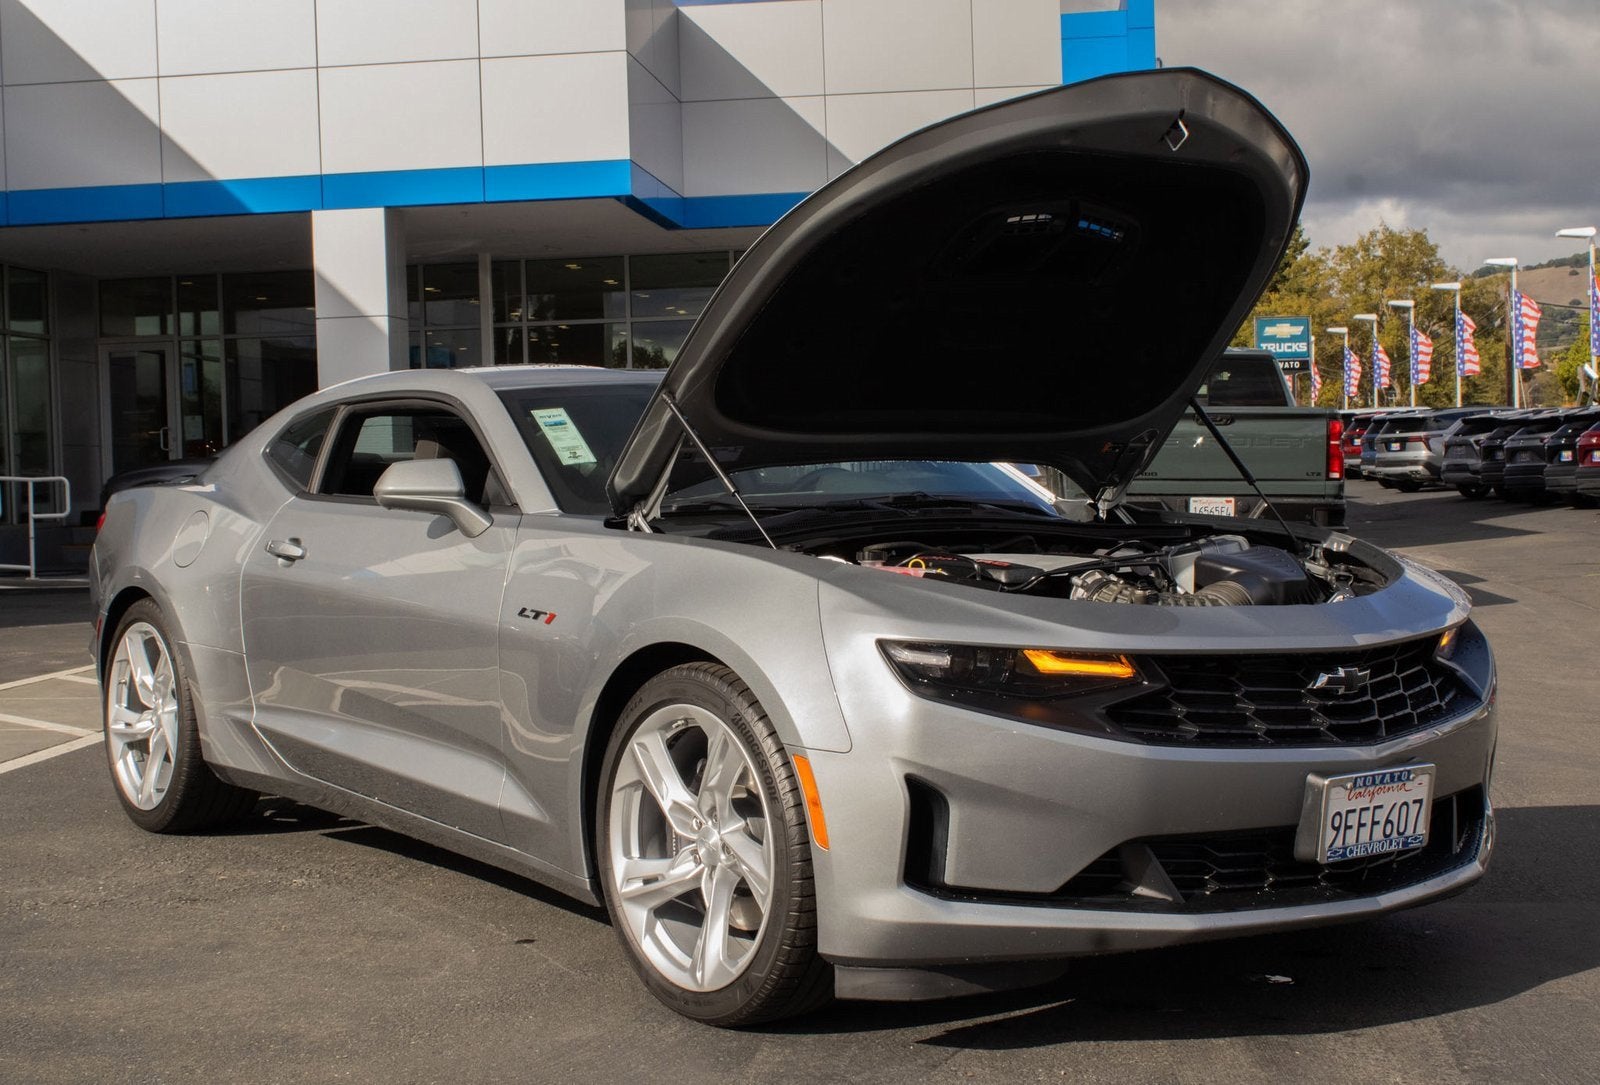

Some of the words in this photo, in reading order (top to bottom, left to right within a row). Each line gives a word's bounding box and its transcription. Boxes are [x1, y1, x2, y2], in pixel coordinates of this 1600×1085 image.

[1260, 342, 1308, 352] TRUCKS
[1279, 361, 1300, 369] VATO
[517, 607, 557, 625] LT1
[731, 712, 780, 805] BRIDGESTONE
[1356, 770, 1409, 788] NOVATO
[1346, 782, 1413, 803] California
[1328, 798, 1424, 849] 9FFF607
[1346, 838, 1405, 858] CHEVROLET
